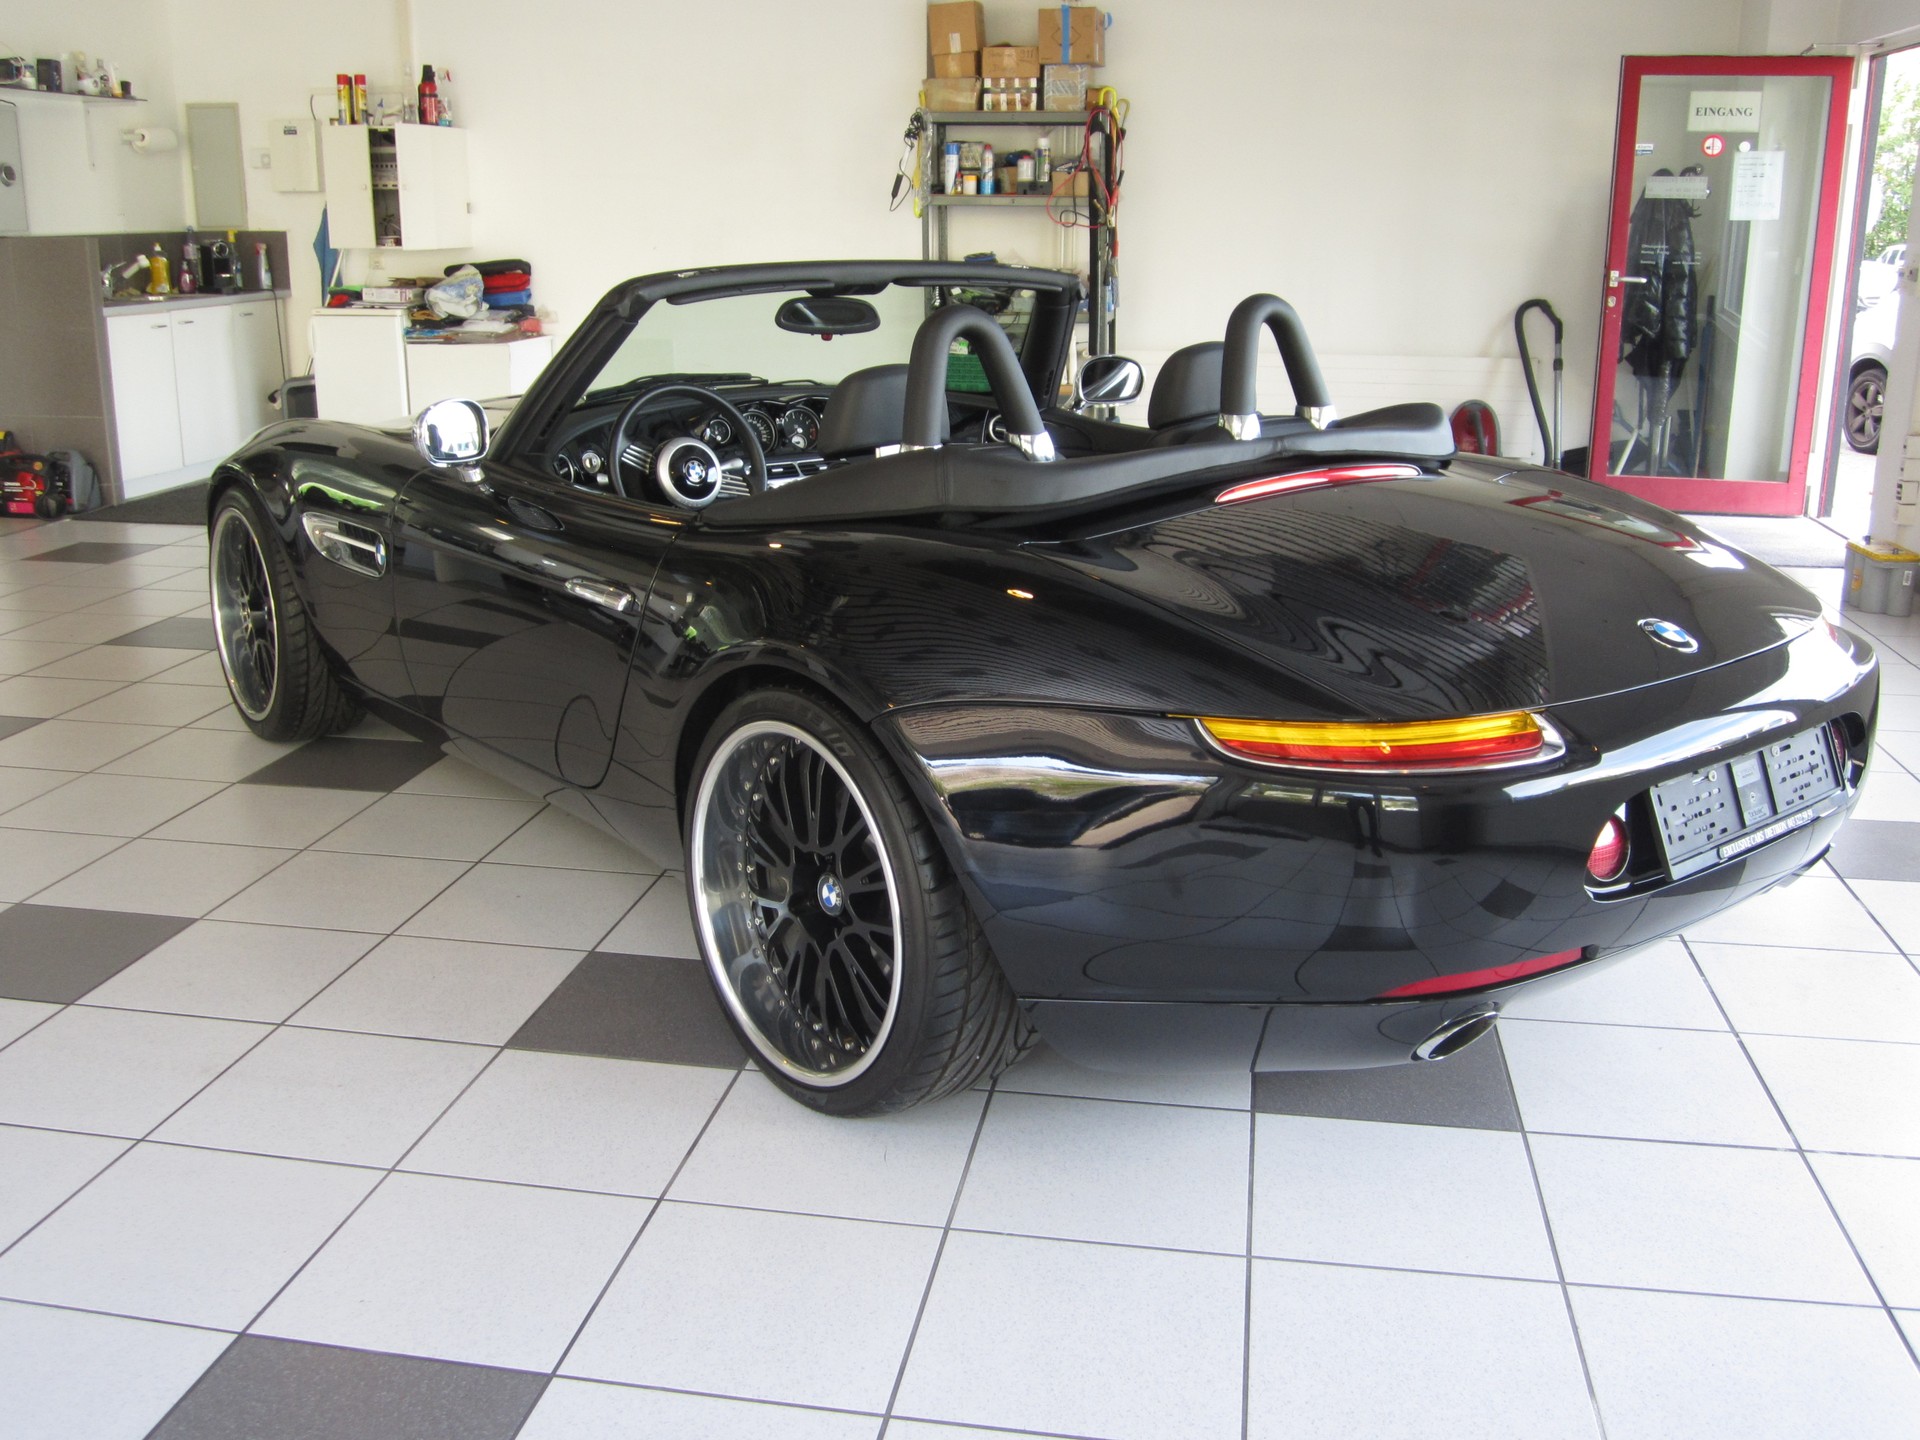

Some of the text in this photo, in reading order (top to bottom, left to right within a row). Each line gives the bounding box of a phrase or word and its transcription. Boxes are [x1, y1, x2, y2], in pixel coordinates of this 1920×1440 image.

[1695, 106, 1753, 117] EINGANG
[1723, 837, 1751, 858] EXCLUSIVE
[1751, 831, 1764, 846] CARS
[829, 877, 842, 907] BMW
